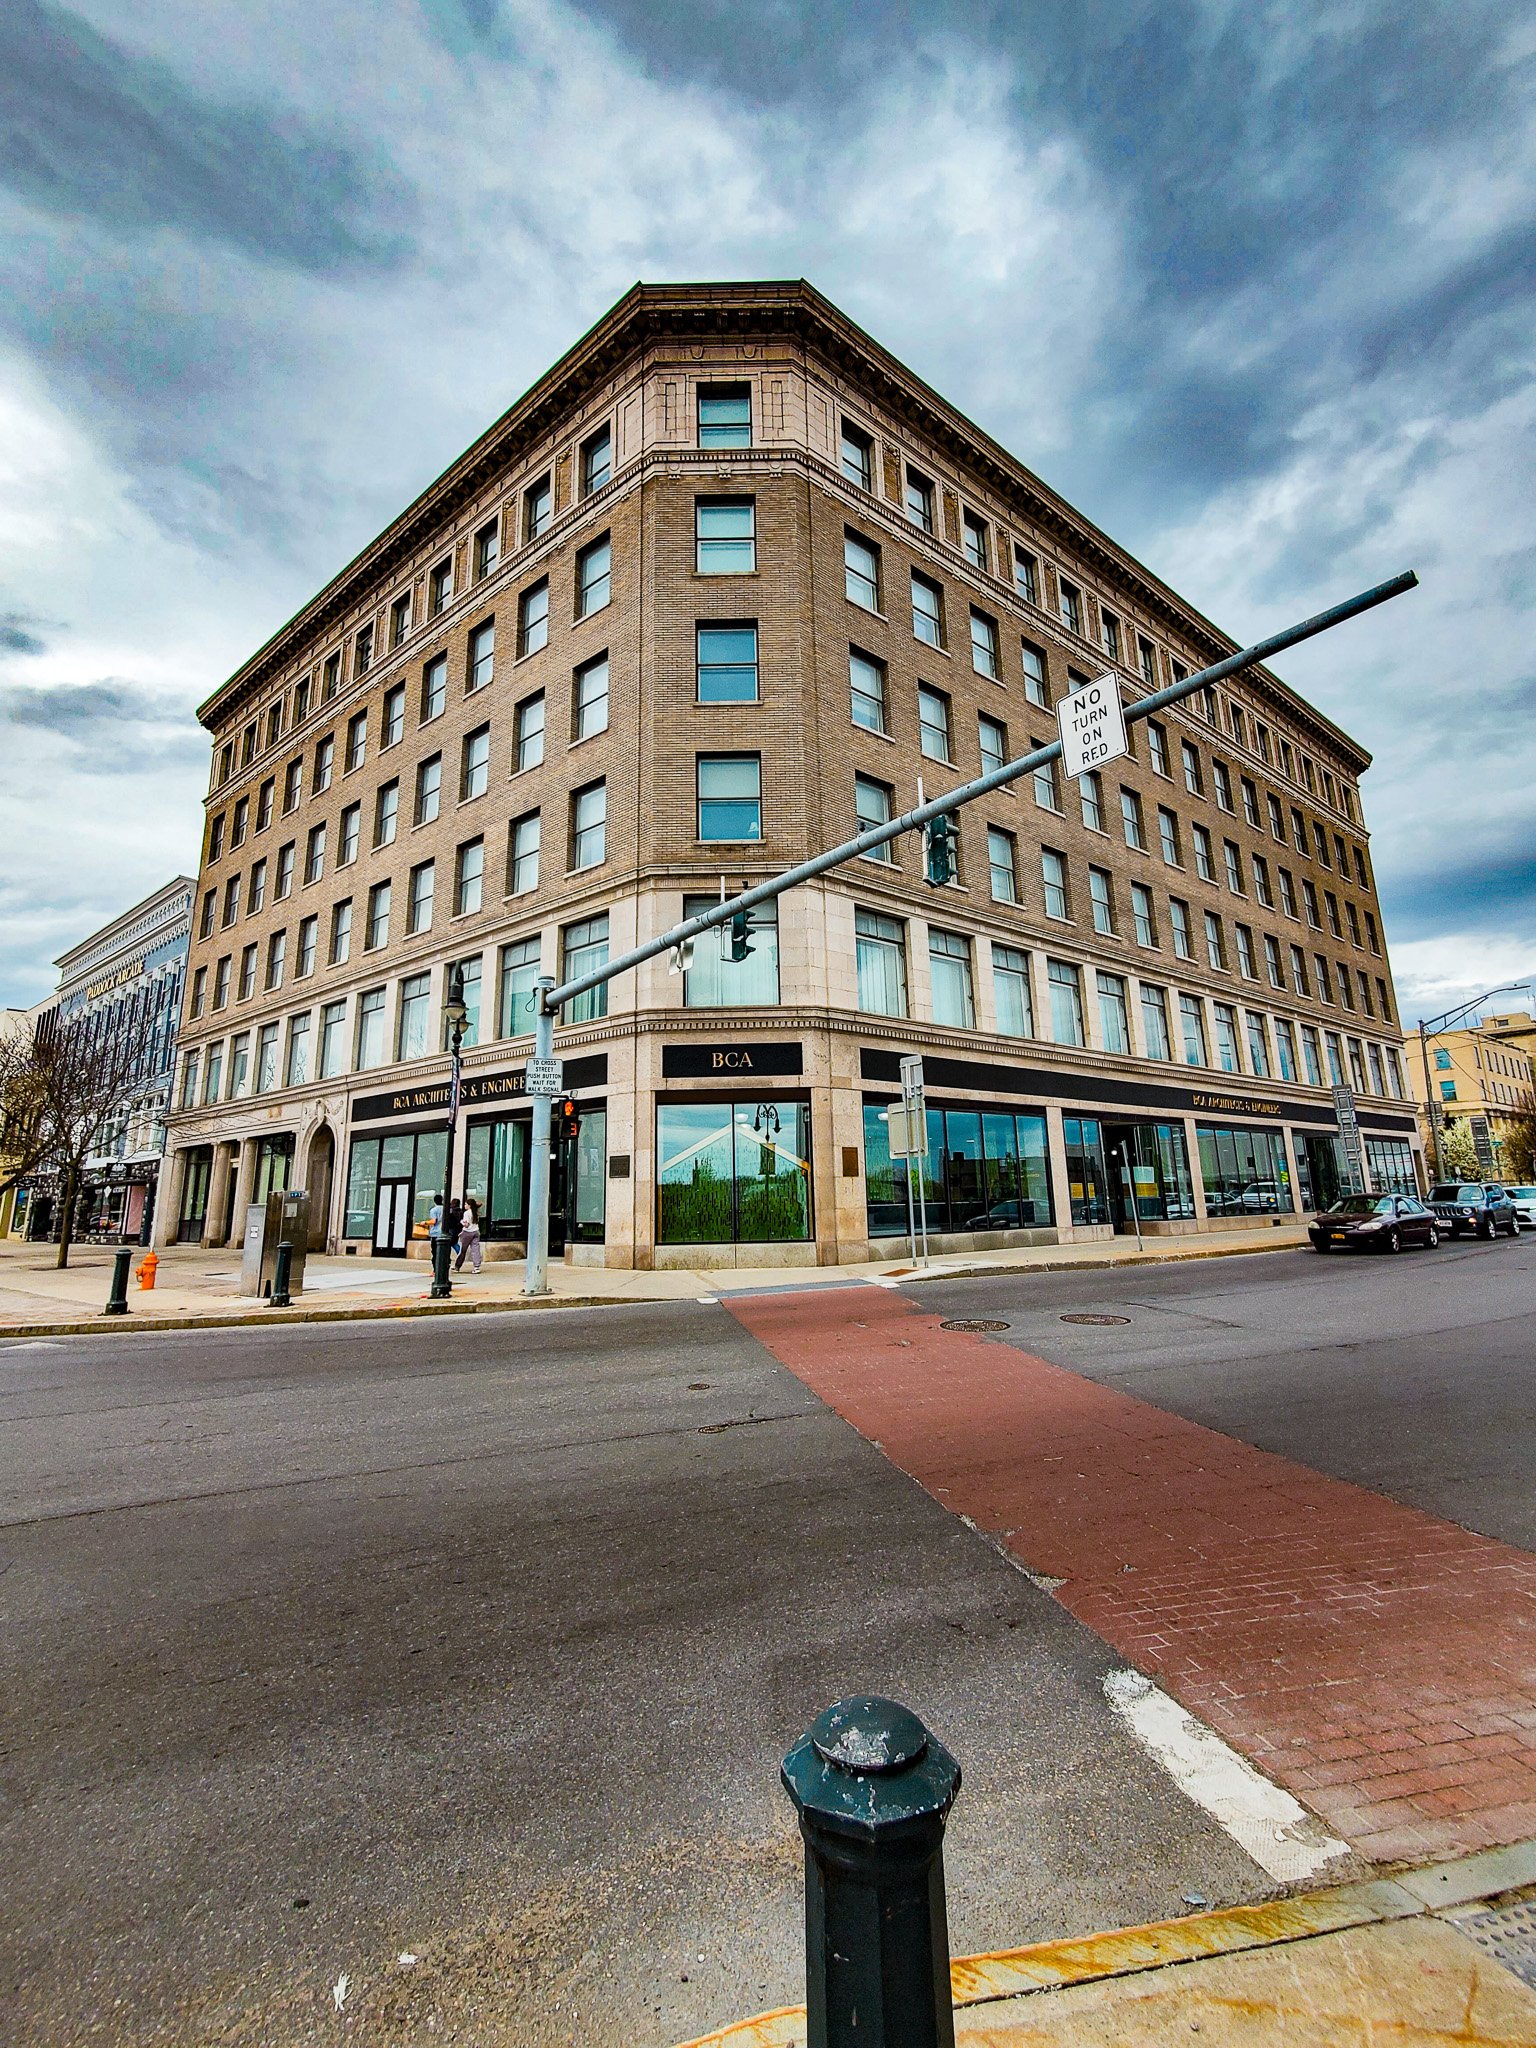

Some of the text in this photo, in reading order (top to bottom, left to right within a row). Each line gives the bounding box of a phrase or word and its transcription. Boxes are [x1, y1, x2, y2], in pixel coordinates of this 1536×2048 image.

[1074, 688, 1101, 714] NO
[1072, 705, 1108, 732] TURN
[1082, 726, 1102, 745] ON
[1081, 743, 1108, 764] RED
[87, 961, 144, 1001] PADDOCK ARCADE
[711, 1051, 754, 1068] BCA
[393, 1075, 527, 1109] BCA ARCHITES & ENGINEE
